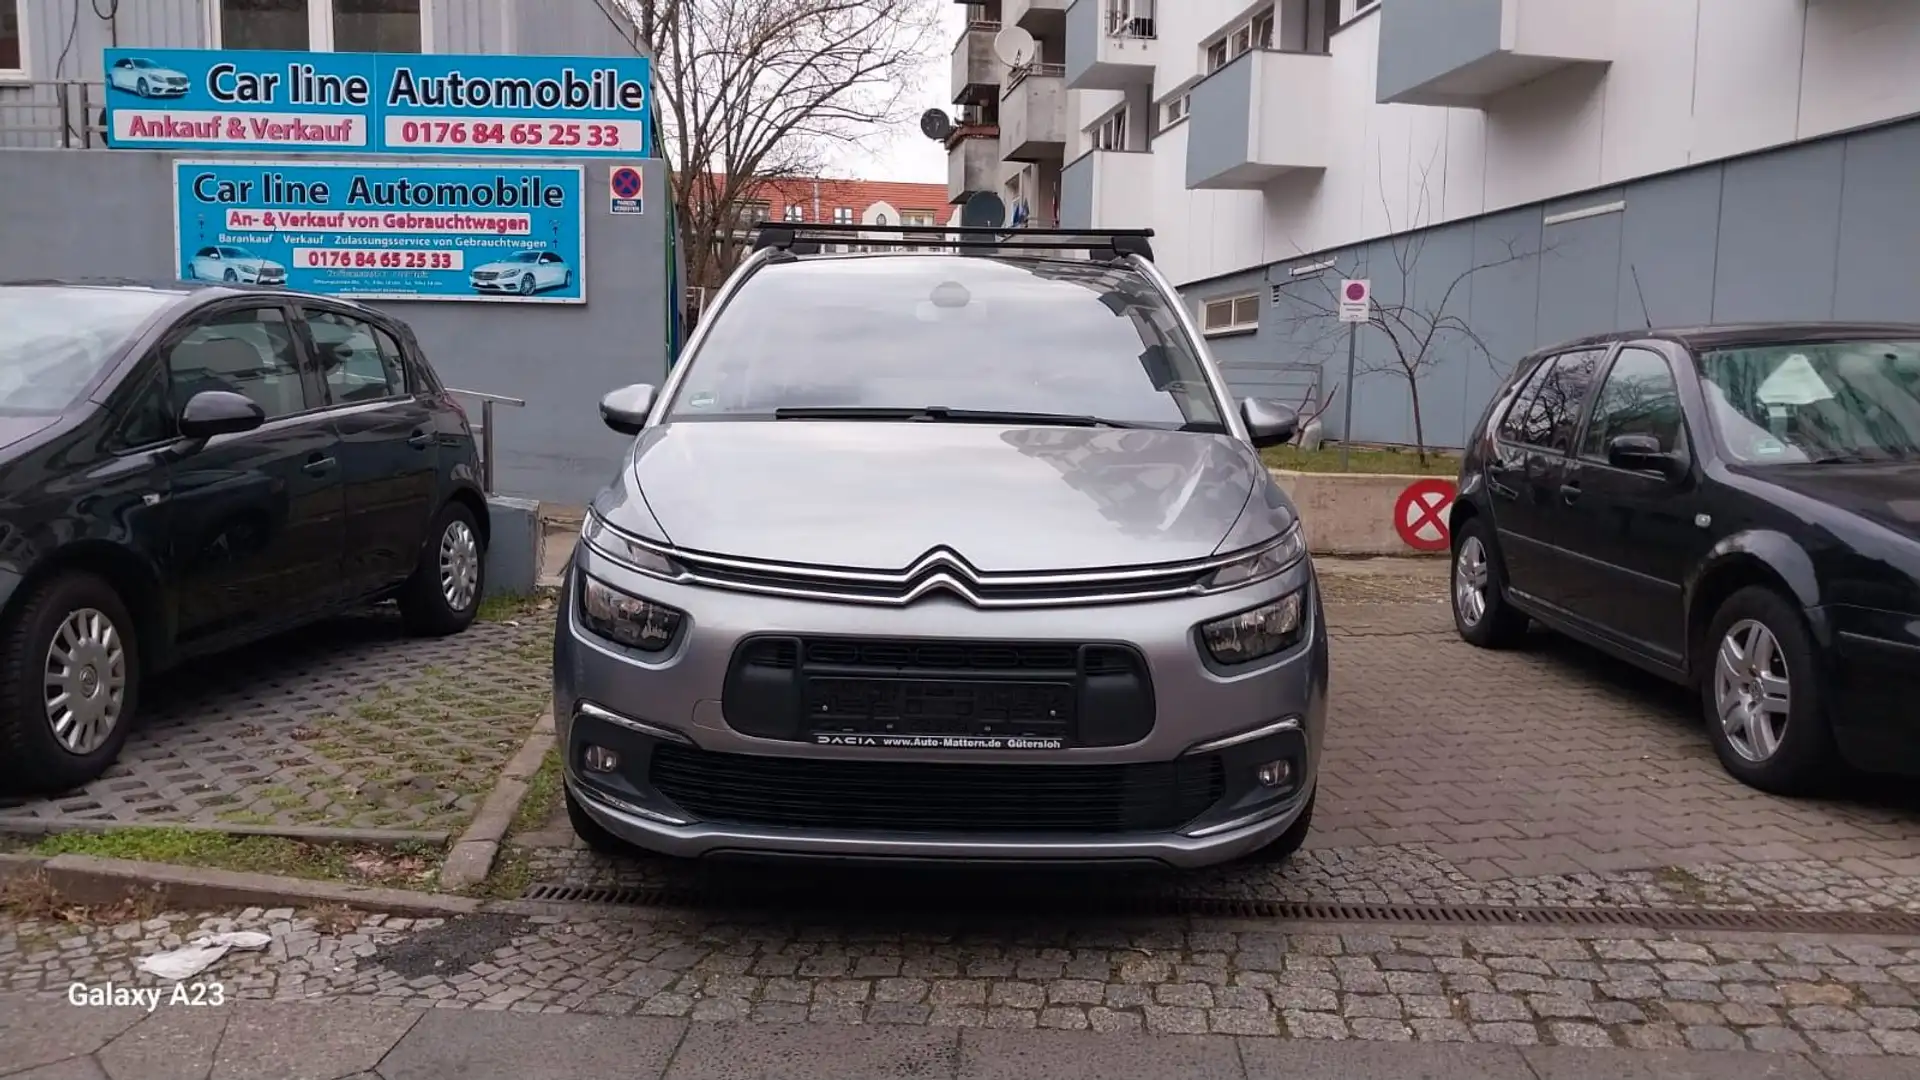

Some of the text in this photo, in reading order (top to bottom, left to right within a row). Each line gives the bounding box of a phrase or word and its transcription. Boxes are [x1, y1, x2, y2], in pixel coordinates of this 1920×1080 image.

[207, 64, 644, 111] Car line Automobile
[129, 115, 352, 142] Ankauf & Verkauf
[402, 122, 619, 147] 0176 84 65 25 33
[193, 172, 565, 209] Car line Automobile
[229, 212, 528, 233] An- & Verkauf von Gebrauchtwagen
[218, 233, 547, 250] Barankauf Verkauf Zulassungsservice von Gebrauchtwagen
[308, 251, 451, 269] 0176 84 65 25 33
[817, 736, 1061, 749] DACIA www.Auto-Mattern.de Gütersloh
